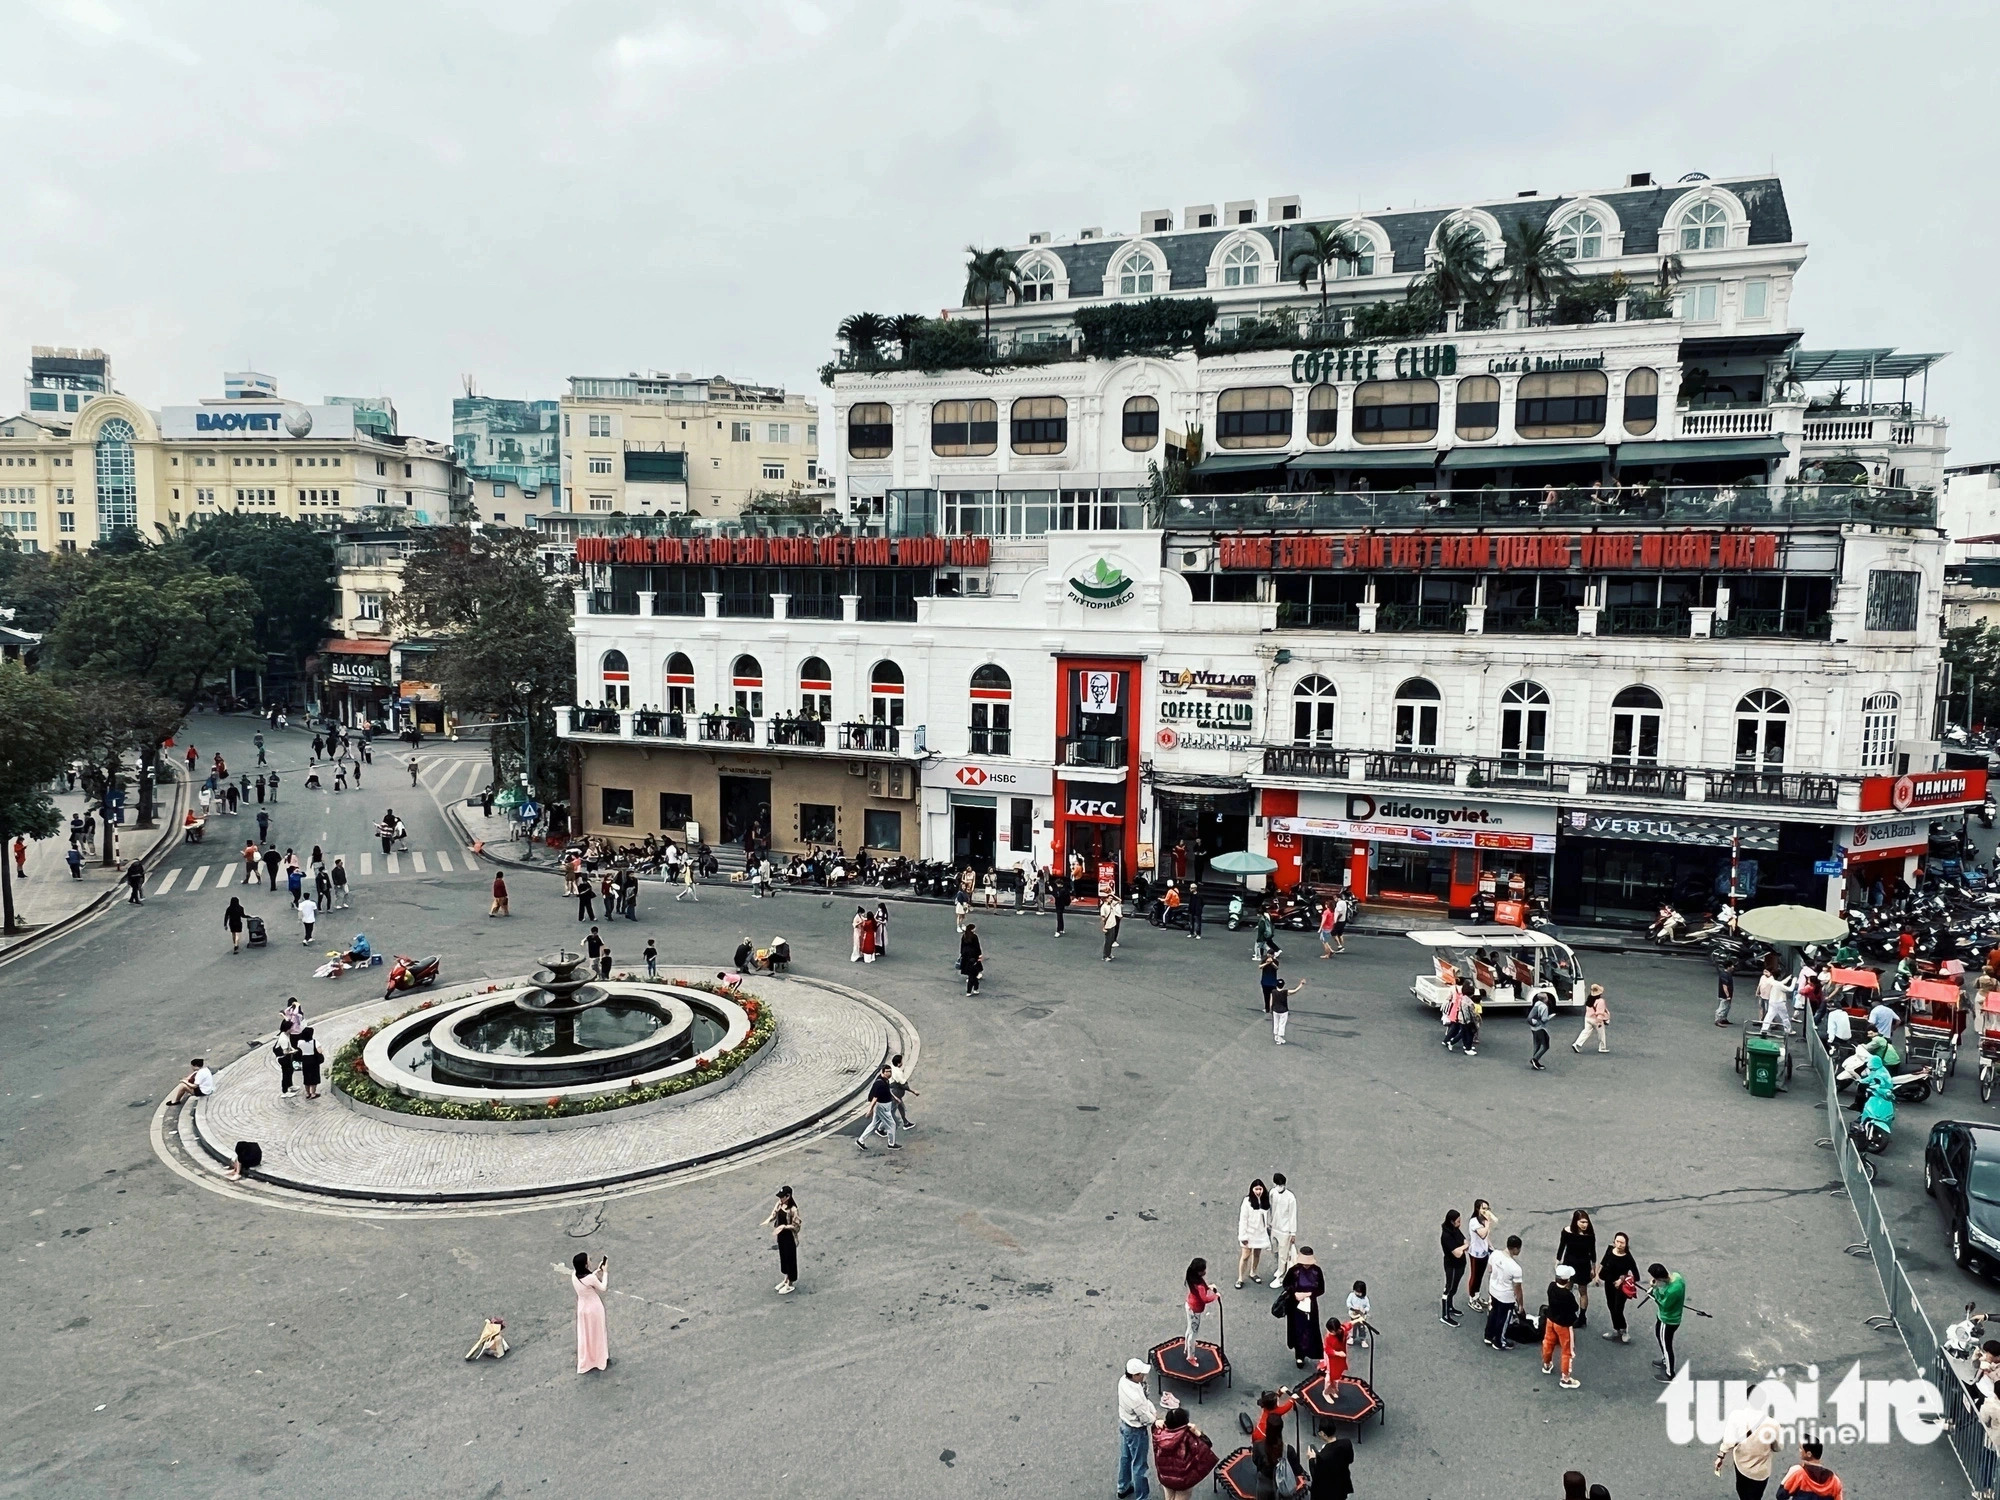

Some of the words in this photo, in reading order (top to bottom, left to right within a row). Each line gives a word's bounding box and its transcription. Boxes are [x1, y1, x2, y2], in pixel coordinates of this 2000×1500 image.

[1292, 348, 1379, 385] COFFEE
[1395, 344, 1457, 379] CLUB
[1522, 356, 1531, 373] &
[1536, 351, 1605, 372] Restaurant
[855, 537, 891, 566] NAM
[1440, 536, 1490, 568] NAM
[1580, 534, 1635, 569] VINH
[1067, 591, 1135, 609] PHYTOPHARCO
[1161, 701, 1212, 720] COFFEE
[1217, 703, 1253, 721] CLUB
[989, 773, 1017, 784] HSBC
[1066, 799, 1117, 818] KFC
[1379, 802, 1503, 825] didongviet.vn
[1595, 817, 1673, 835] VERTU
[1869, 821, 1917, 841] SeABank
[1276, 833, 1292, 843] 03
